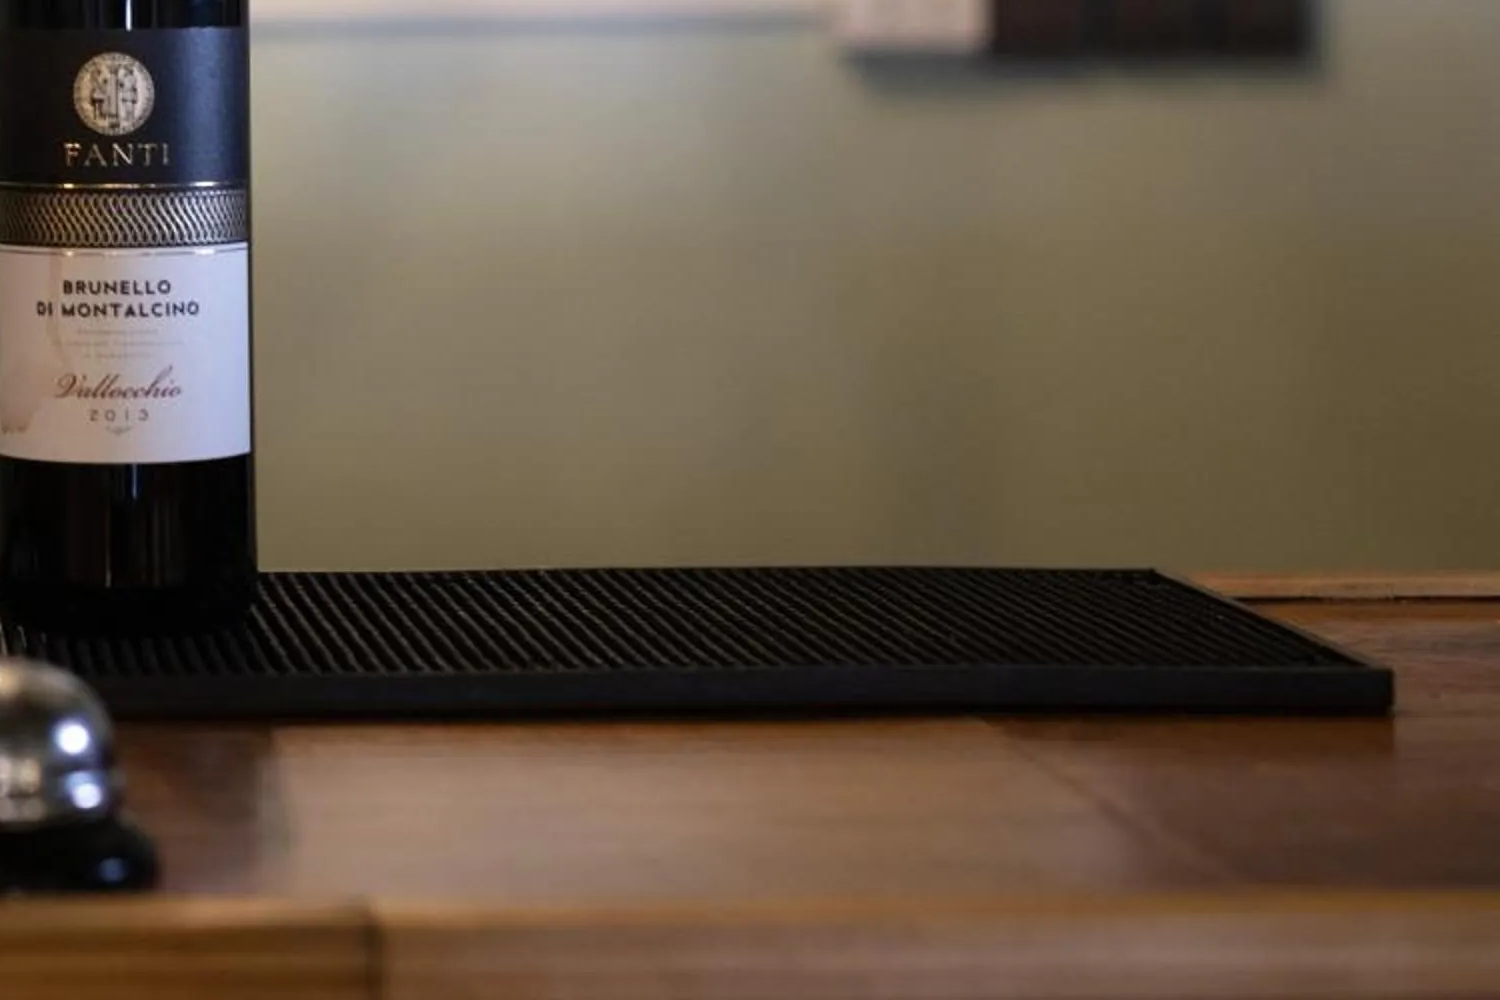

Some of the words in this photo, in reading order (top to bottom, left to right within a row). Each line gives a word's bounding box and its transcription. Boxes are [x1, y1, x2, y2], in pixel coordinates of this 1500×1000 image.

[63, 142, 171, 167] FANTI
[63, 280, 171, 295] BRUNELLO
[36, 302, 53, 317] DI
[61, 302, 200, 318] MONTALCINO
[89, 408, 149, 422] 2013
